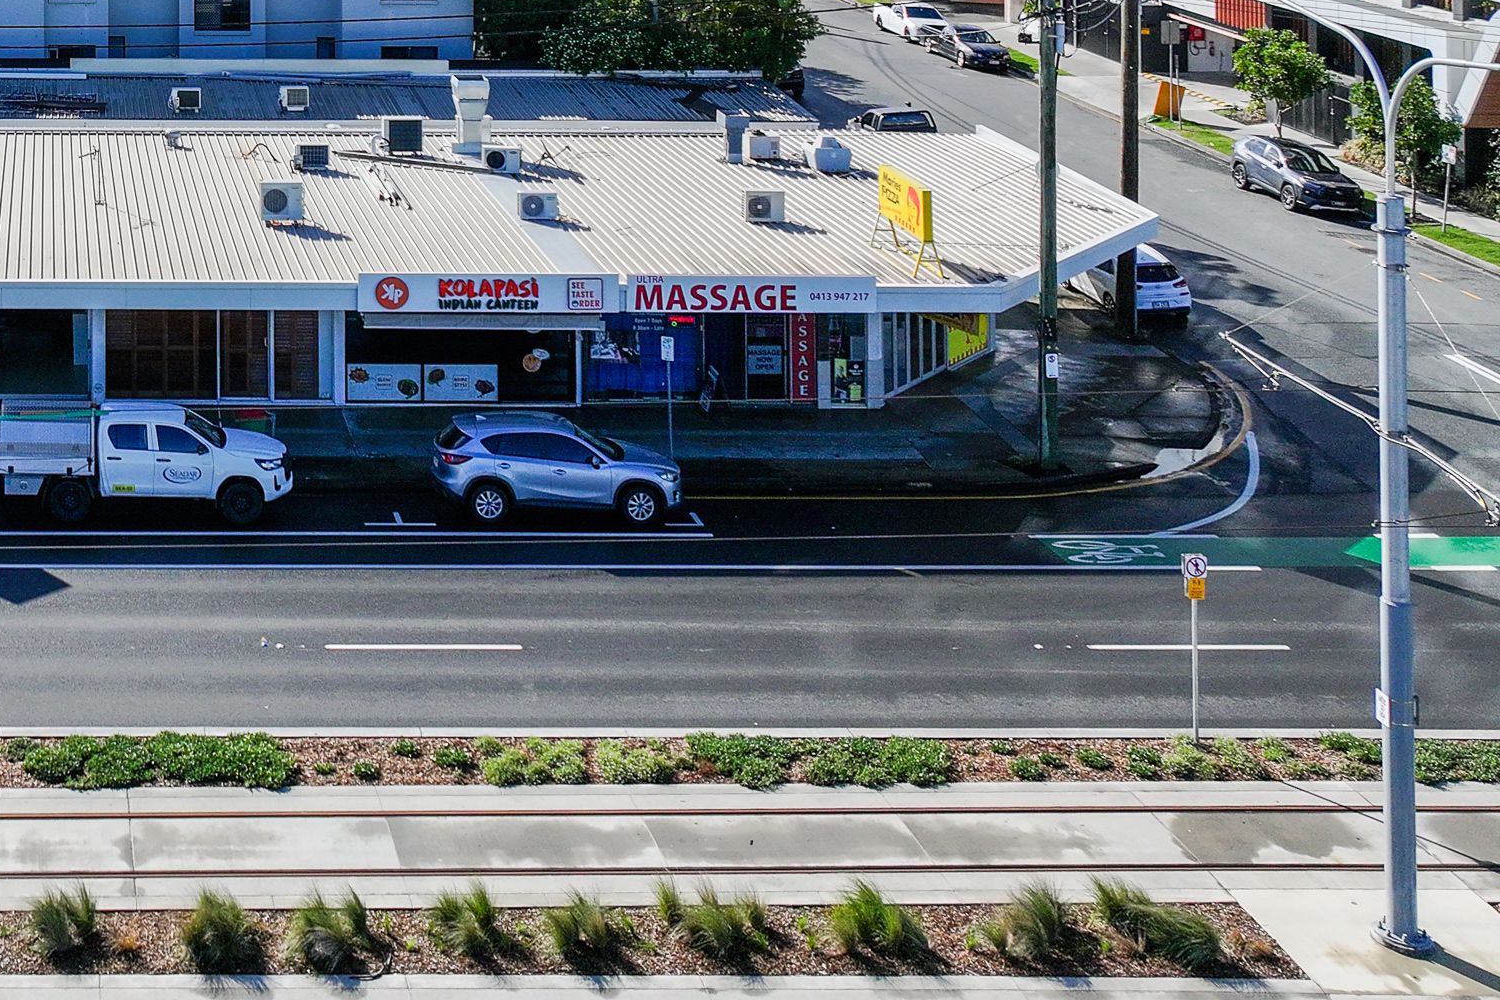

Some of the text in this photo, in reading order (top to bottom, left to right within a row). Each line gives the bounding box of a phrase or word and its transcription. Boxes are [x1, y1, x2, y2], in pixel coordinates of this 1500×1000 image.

[571, 281, 585, 289] SEE
[636, 275, 665, 284] ULTRA
[438, 277, 540, 298] KOLAPASI
[634, 284, 798, 311] MASSAGE
[809, 292, 869, 301] 0413 947 217
[438, 298, 539, 310] INDIAN CANTEEN
[797, 313, 809, 396] ASSAGE
